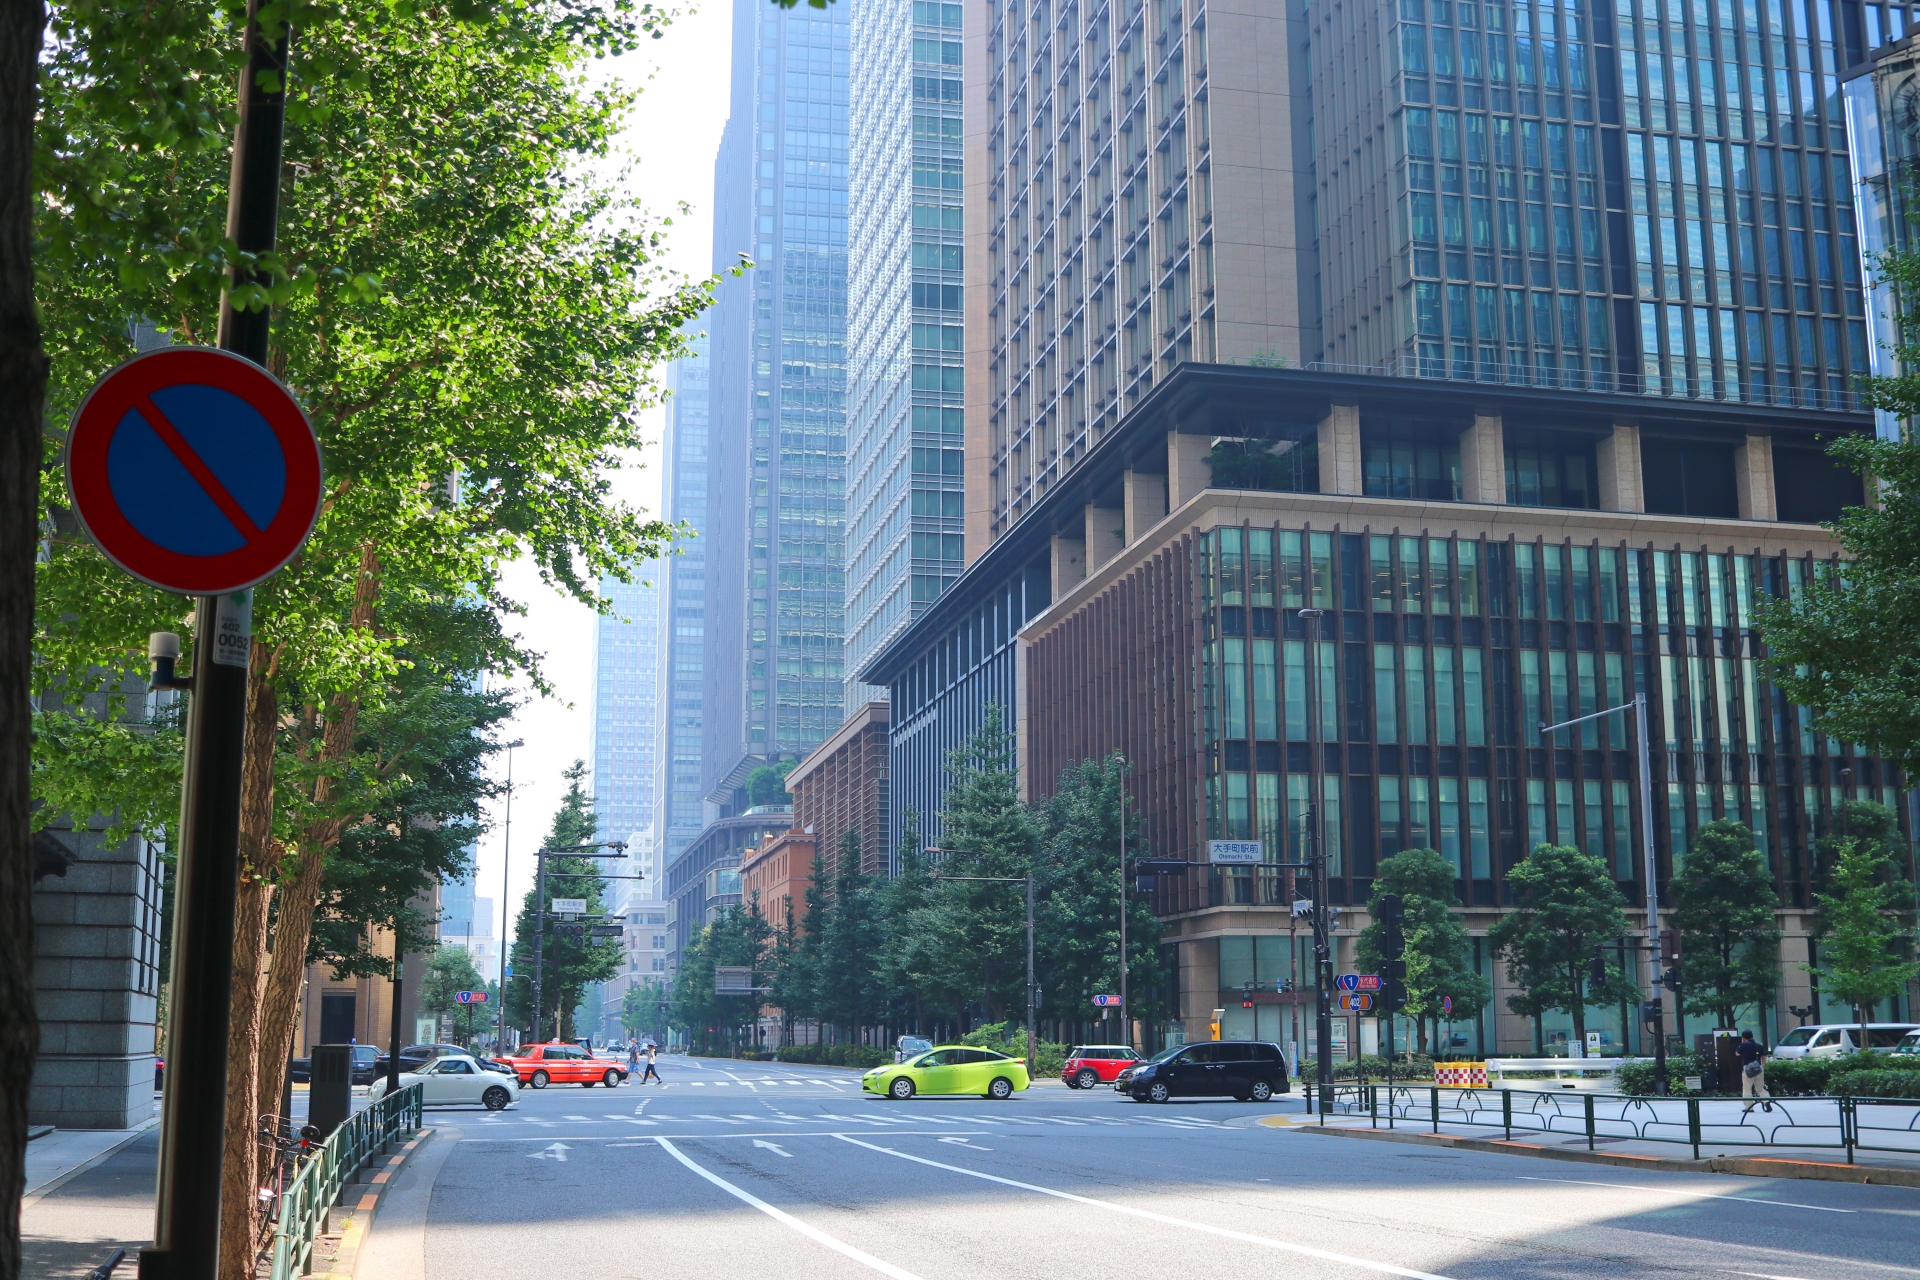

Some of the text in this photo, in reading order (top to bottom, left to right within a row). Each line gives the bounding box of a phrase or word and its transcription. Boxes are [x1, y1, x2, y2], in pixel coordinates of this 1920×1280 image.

[222, 622, 240, 632] 402
[218, 633, 249, 650] 0052
[1213, 843, 1259, 854] 大手町駅前
[1348, 976, 1353, 986] 1
[1350, 998, 1360, 1006] 402
